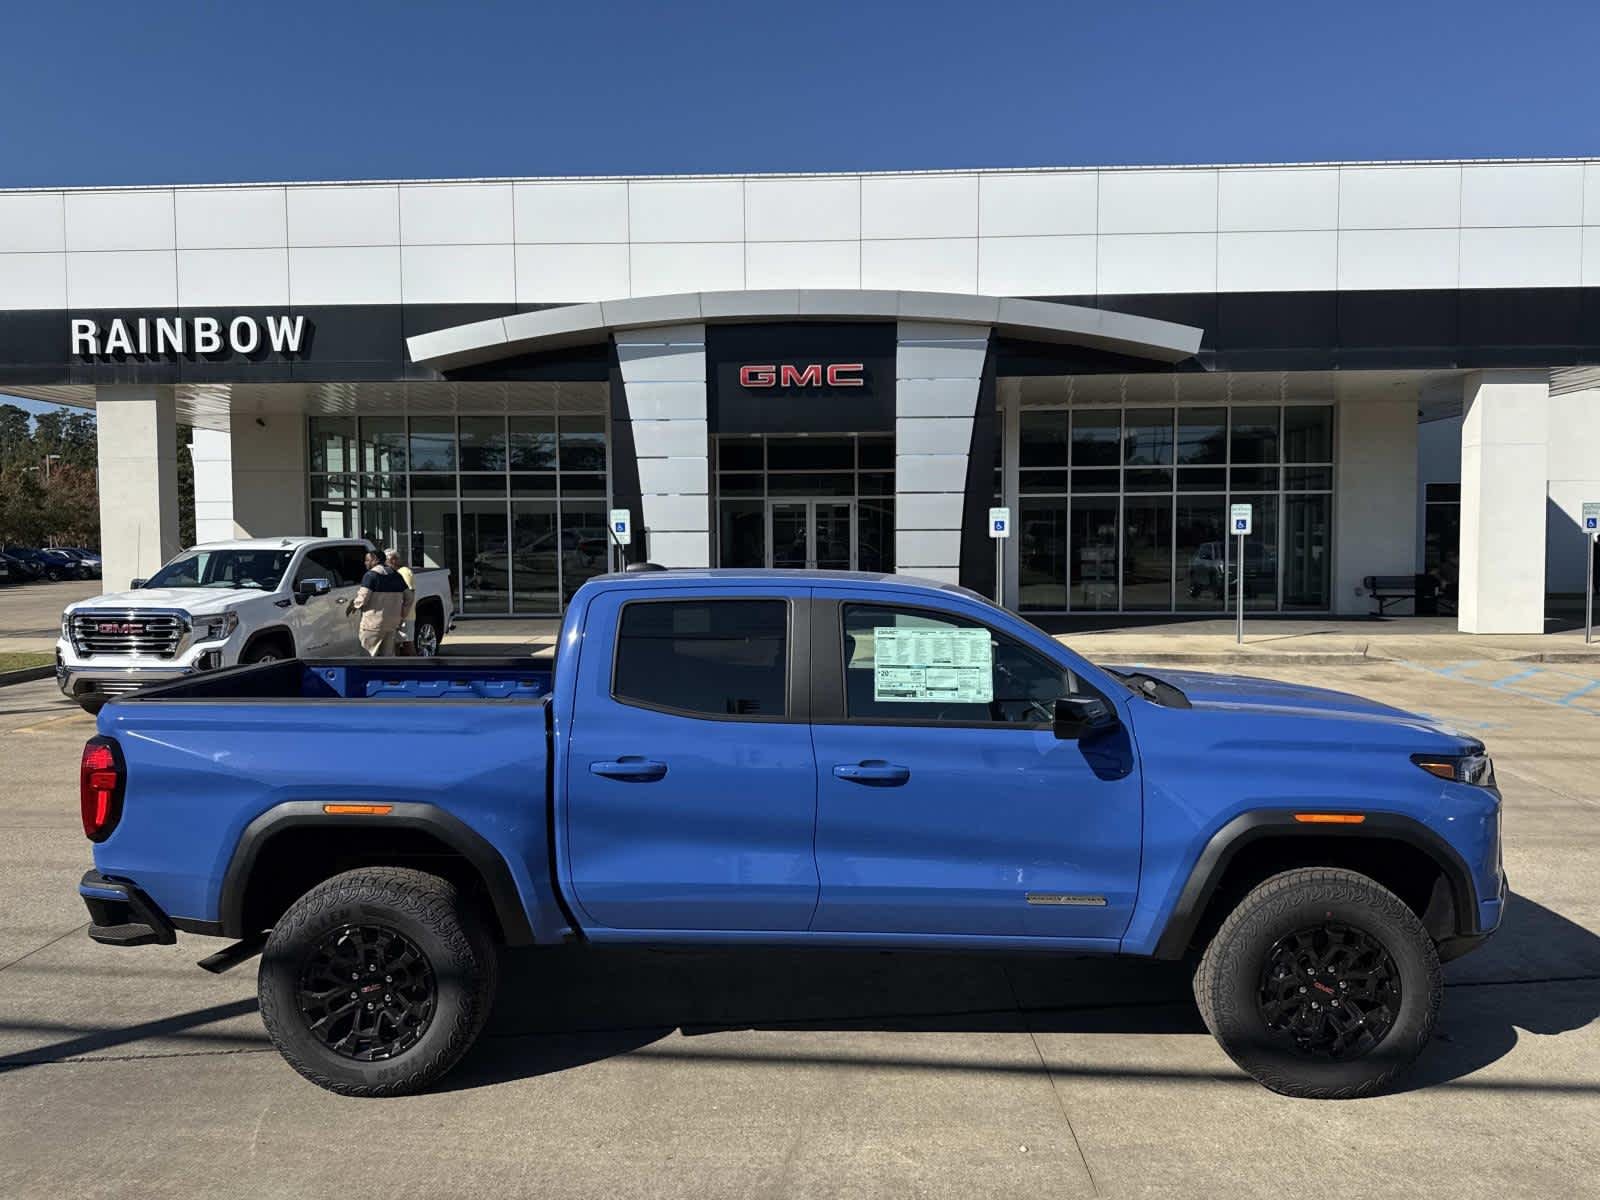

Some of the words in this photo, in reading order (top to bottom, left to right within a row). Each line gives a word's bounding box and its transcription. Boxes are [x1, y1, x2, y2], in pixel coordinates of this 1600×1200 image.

[71, 315, 304, 355] RAINBOW
[740, 363, 864, 387] GMC
[99, 623, 143, 633] GMC
